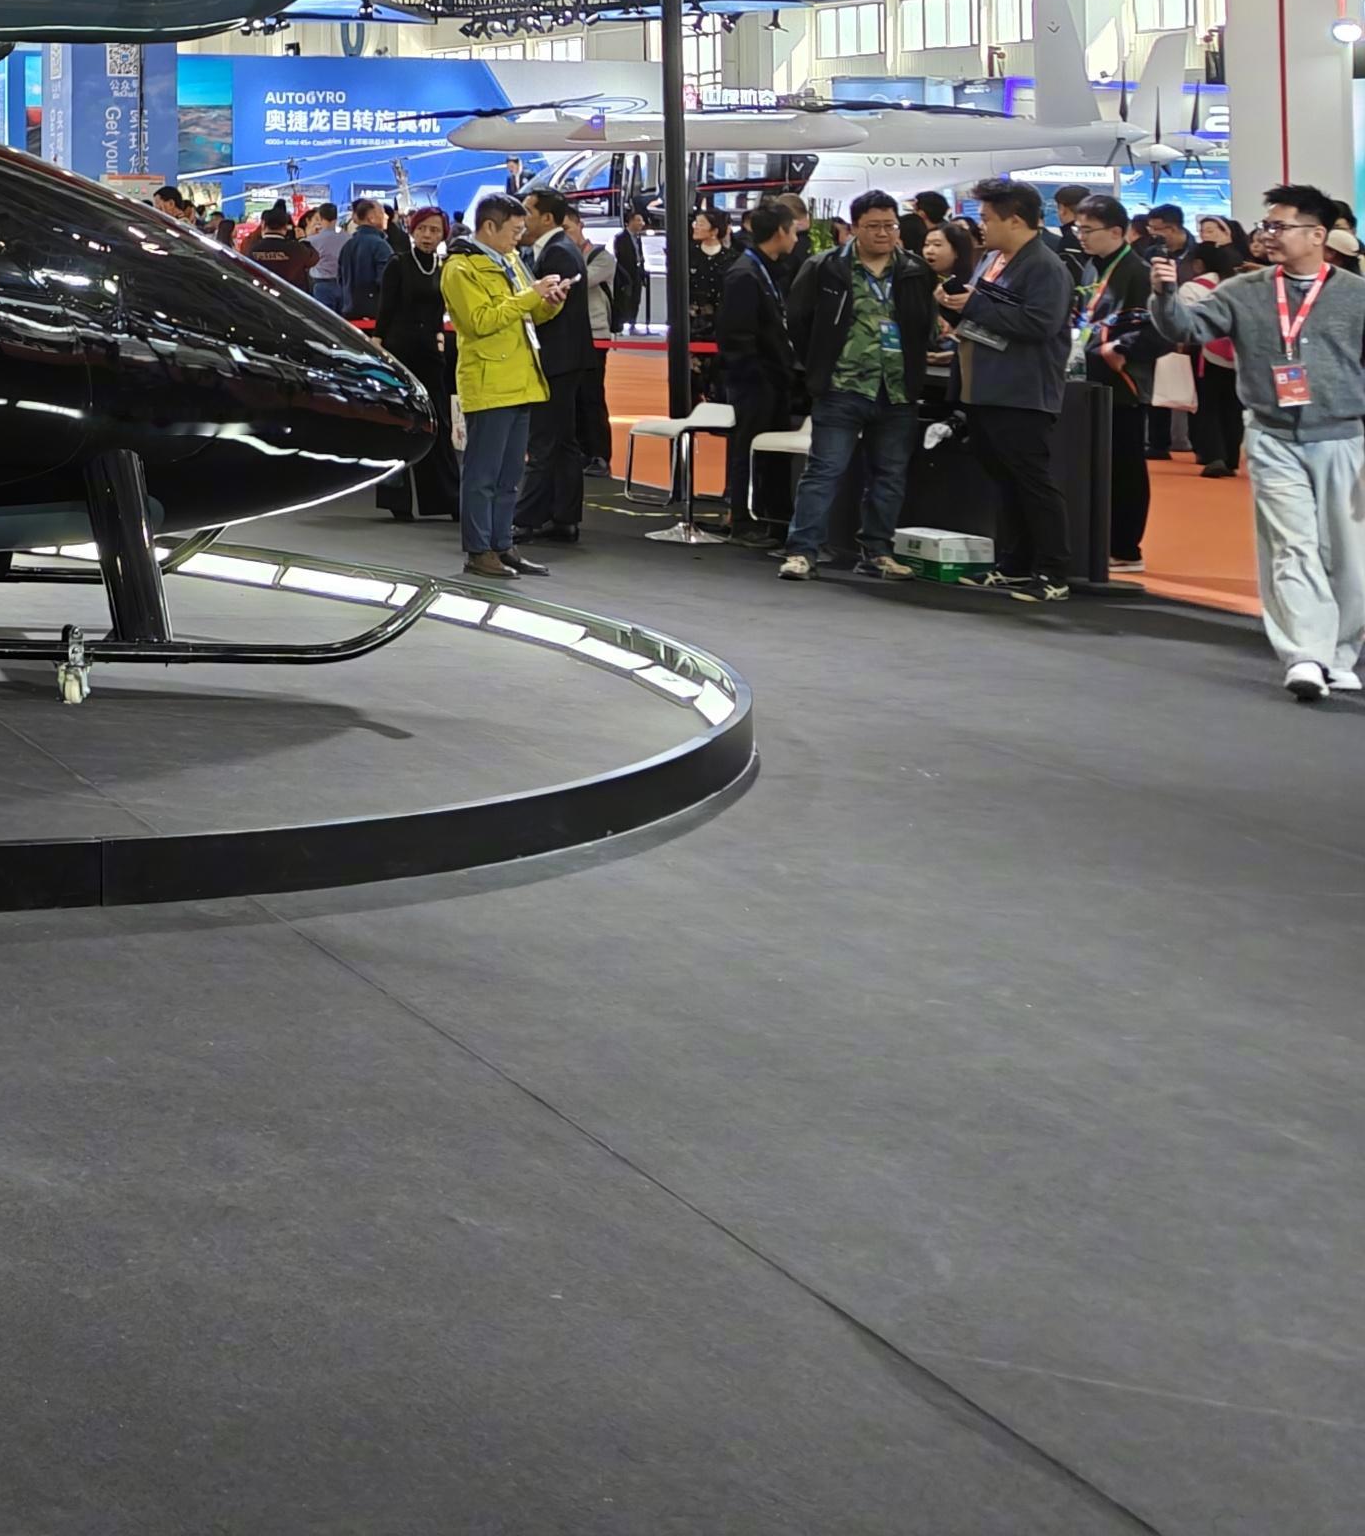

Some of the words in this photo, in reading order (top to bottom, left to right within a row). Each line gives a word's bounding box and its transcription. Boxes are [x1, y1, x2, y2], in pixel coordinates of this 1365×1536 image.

[264, 91, 346, 105] AUTOGYRO
[105, 106, 121, 135] Get
[867, 156, 960, 168] VOLANT
